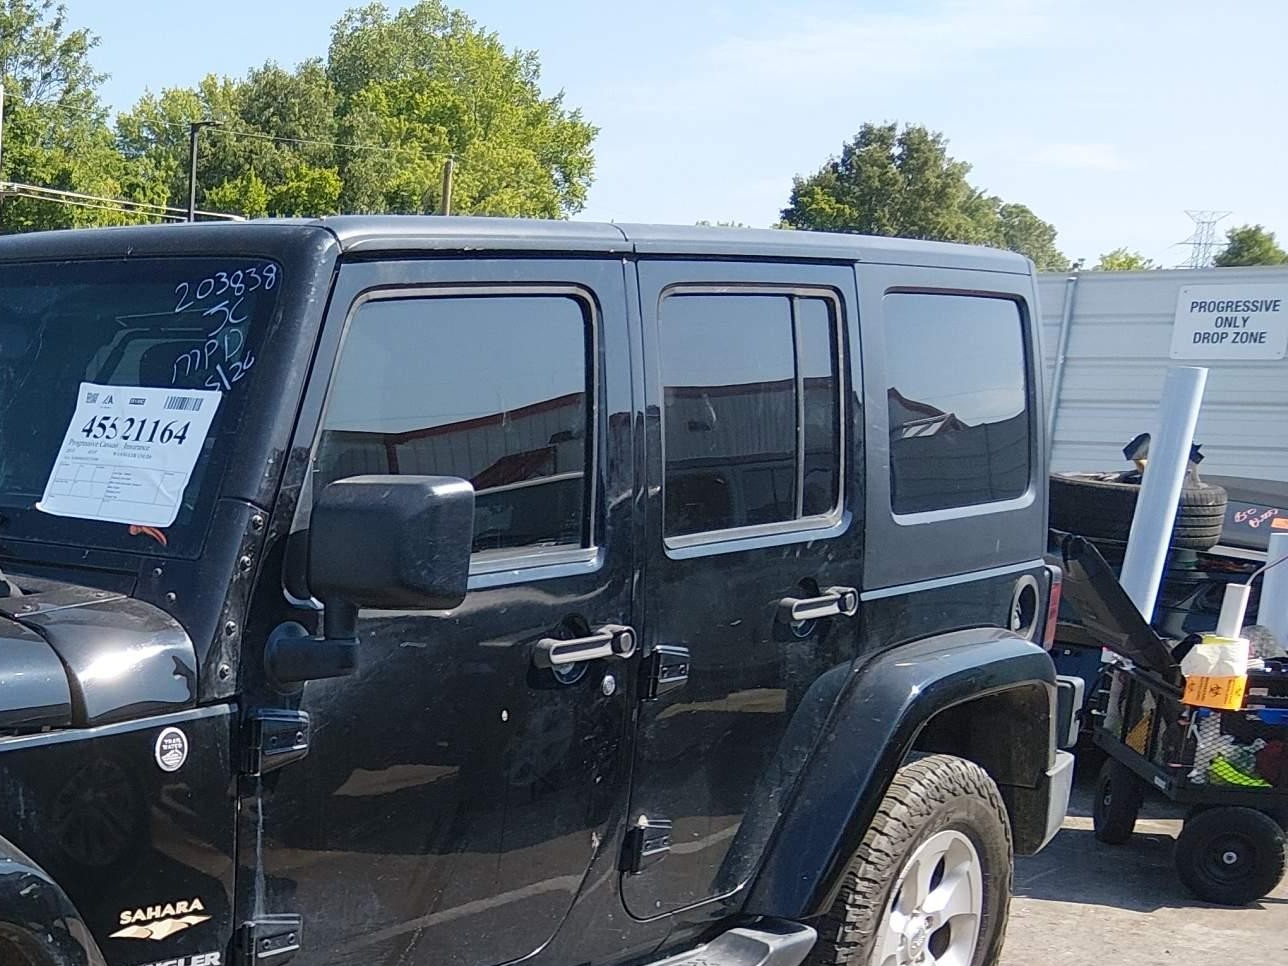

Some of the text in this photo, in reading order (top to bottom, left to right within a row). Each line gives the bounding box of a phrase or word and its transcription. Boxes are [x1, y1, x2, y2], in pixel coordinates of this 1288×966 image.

[174, 263, 277, 313] 203838
[1190, 299, 1281, 313] PROGRESSIVE
[1214, 315, 1250, 329] ONLY
[1192, 331, 1268, 344] DROP ZONE
[81, 415, 191, 445] 45521164
[119, 898, 205, 925] SAHARA
